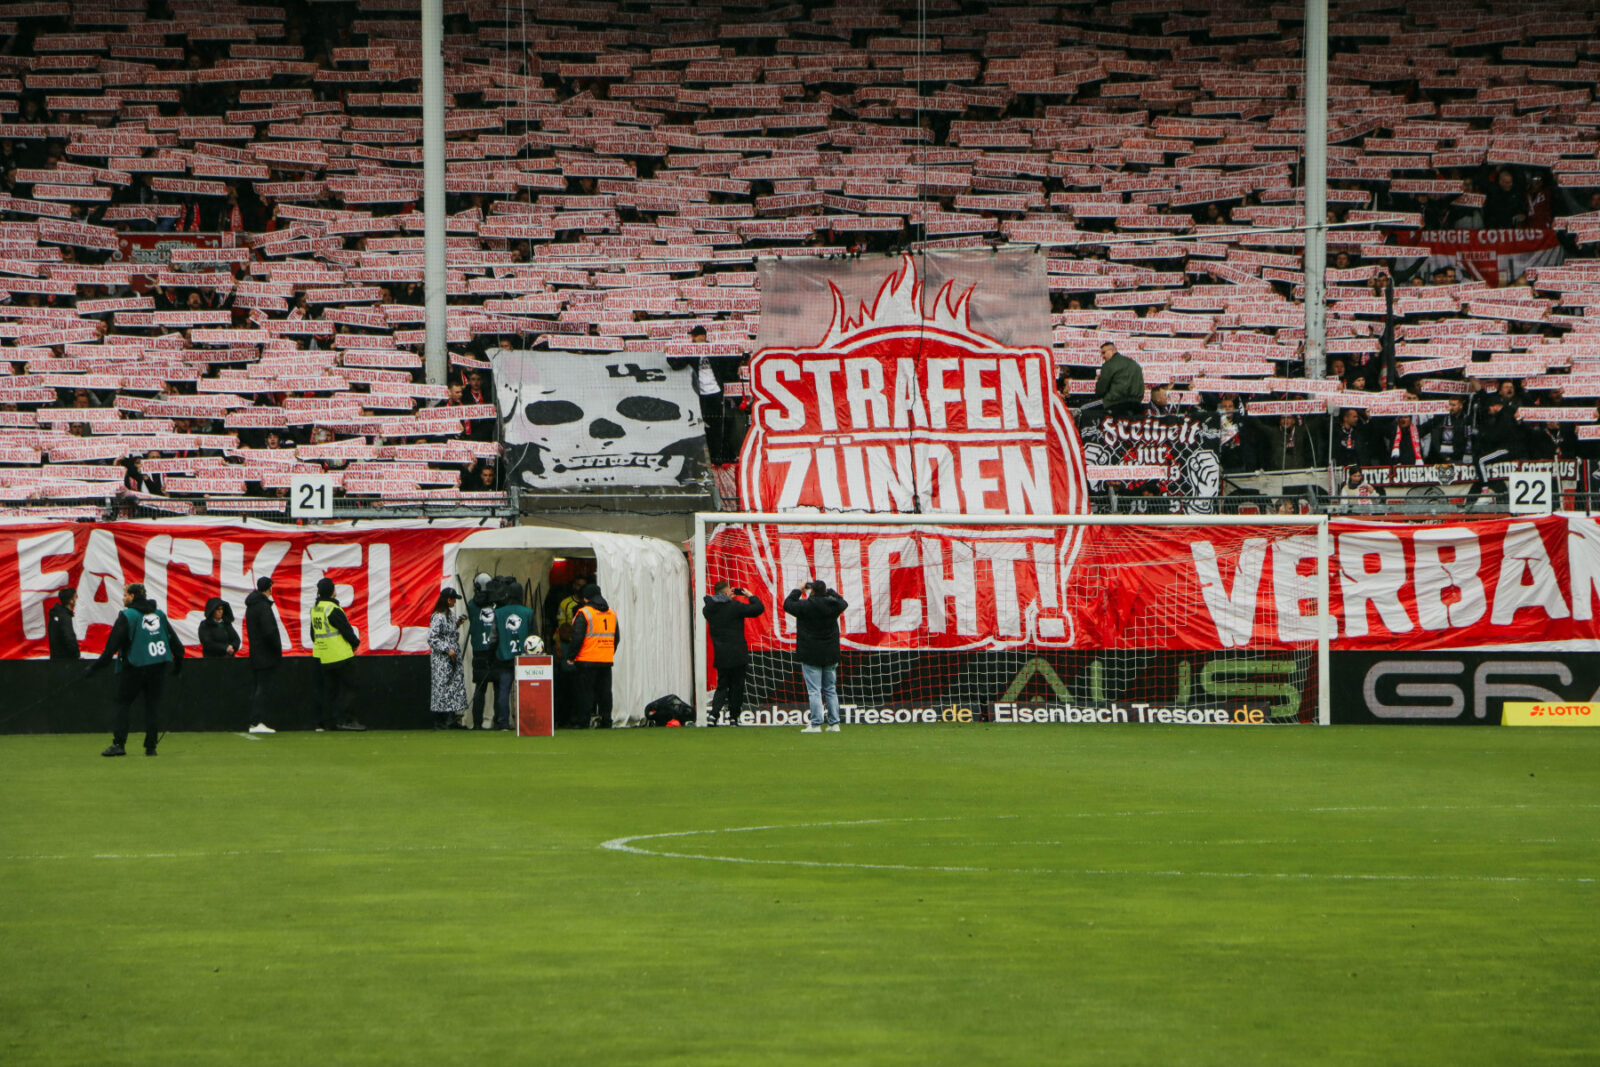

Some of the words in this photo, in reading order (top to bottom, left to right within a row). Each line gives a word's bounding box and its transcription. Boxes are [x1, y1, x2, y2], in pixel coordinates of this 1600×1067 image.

[760, 357, 1046, 431] STRAFEN
[1102, 415, 1201, 447] Freiheit
[1136, 443, 1166, 464] für
[766, 437, 1054, 515] ZÜNDEN
[299, 484, 326, 509] 21
[1514, 480, 1547, 505] 22
[778, 536, 1065, 638] NICHT!
[148, 640, 167, 657] 08
[839, 704, 973, 723] Tresore.de
[994, 703, 1128, 723] Eisenbach
[1131, 703, 1265, 723] Tresore.de
[1548, 705, 1592, 717] LOTTO
